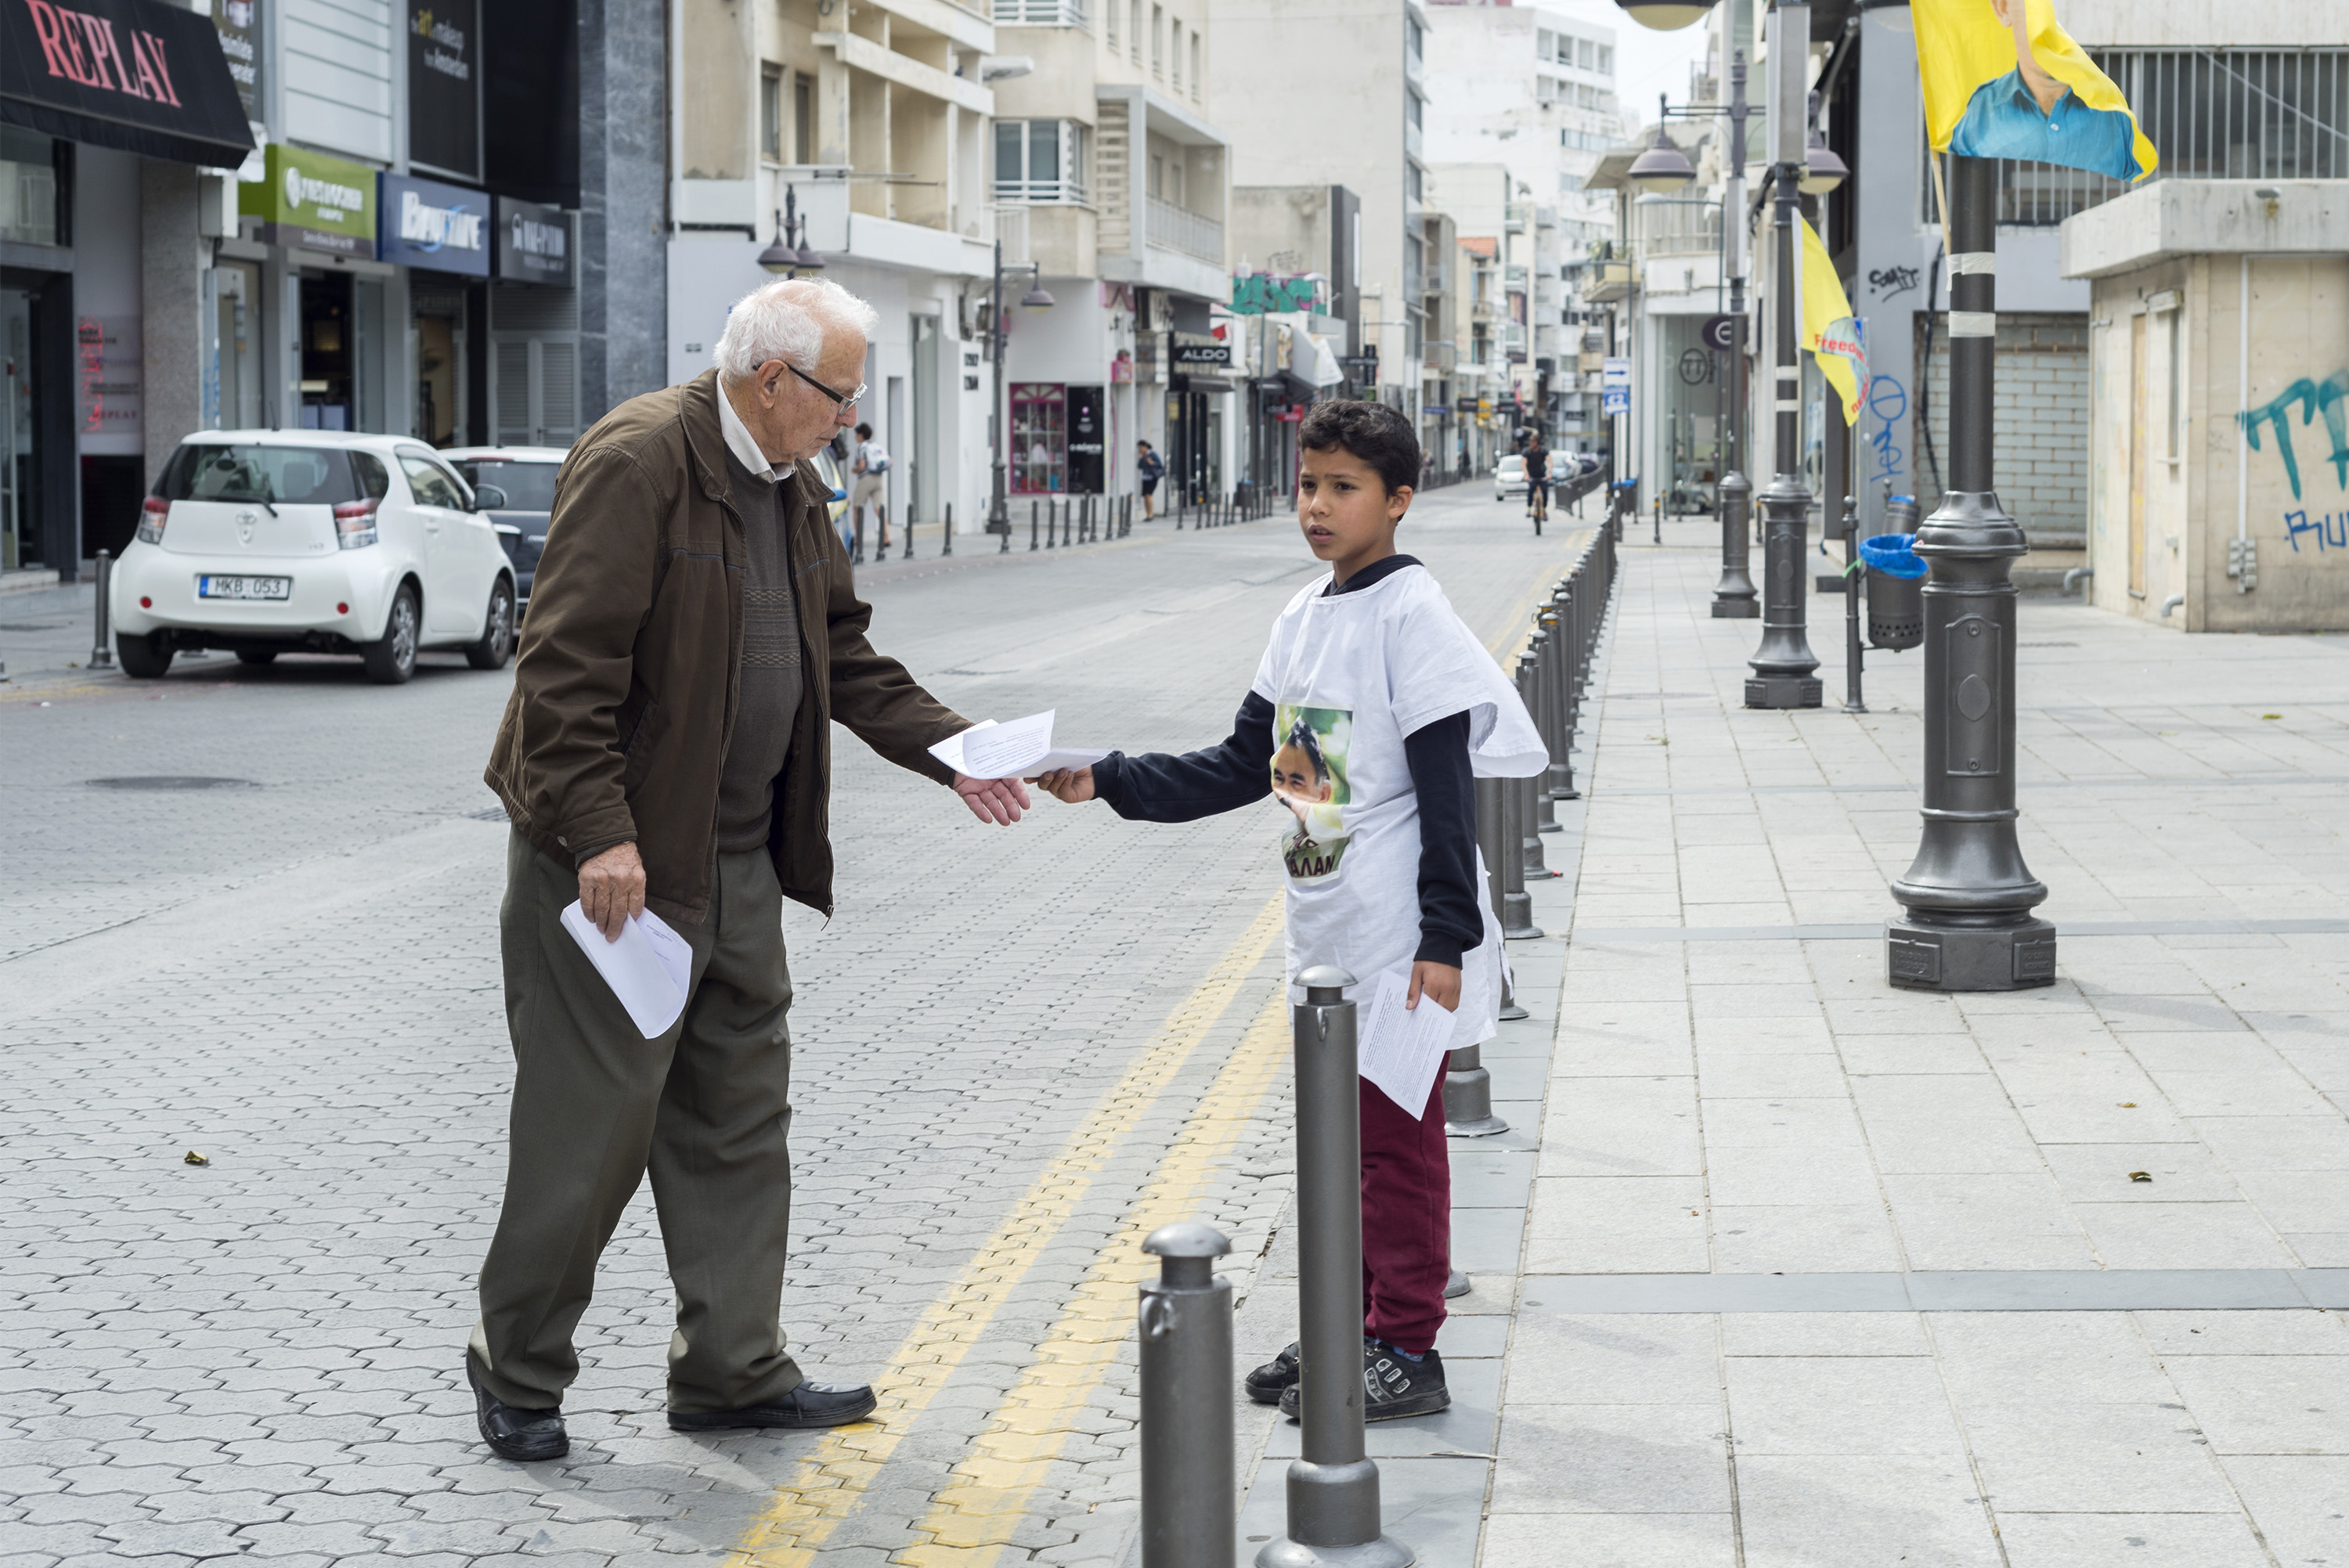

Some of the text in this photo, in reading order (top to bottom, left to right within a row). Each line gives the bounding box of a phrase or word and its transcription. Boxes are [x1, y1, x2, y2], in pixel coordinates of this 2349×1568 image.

[24, 0, 182, 108] REPLAY
[1181, 348, 1229, 361] ALDO
[253, 579, 281, 594] 053
